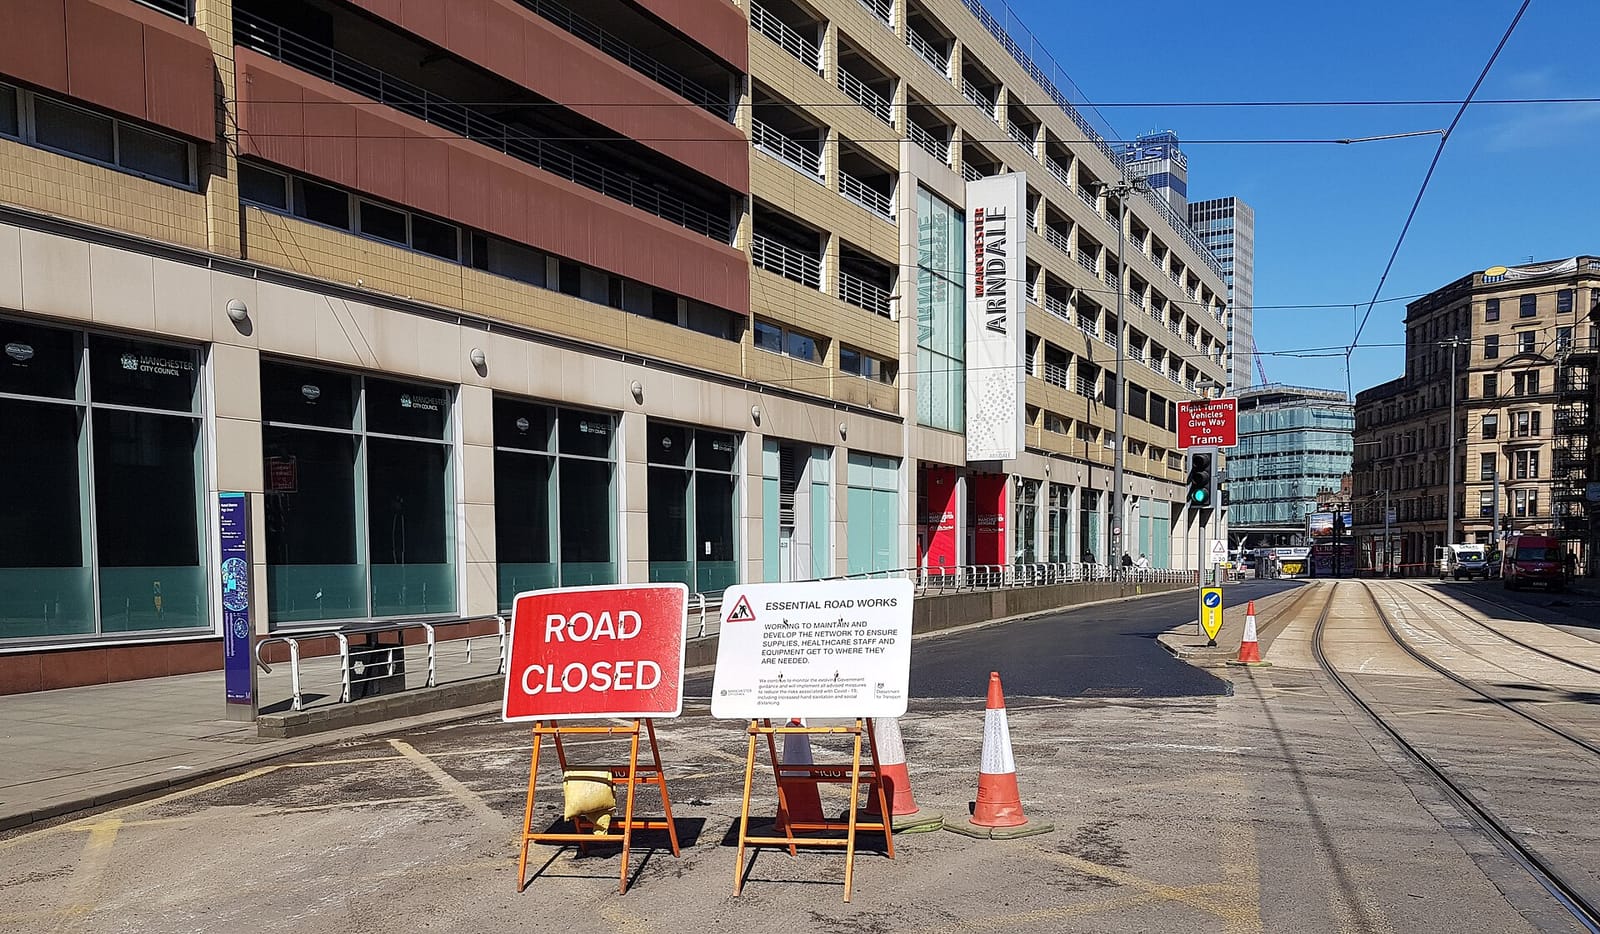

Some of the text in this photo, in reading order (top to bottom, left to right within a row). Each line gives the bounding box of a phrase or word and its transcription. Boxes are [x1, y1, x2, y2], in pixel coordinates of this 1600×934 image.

[974, 207, 984, 298] MANCHESTER
[985, 206, 1007, 335] ARNDALE
[140, 355, 194, 371] MANCHESTER
[140, 364, 180, 377] CITY COUNCIL
[1190, 411, 1223, 419] Vehicles
[1188, 418, 1226, 427] Give Way
[1190, 435, 1223, 445] Trams
[765, 598, 898, 611] ESSENTIAL ROAD WORKS
[544, 610, 643, 643] ROAD
[764, 622, 800, 630] WORKING
[813, 621, 850, 629] MAINTAIN
[851, 620, 868, 628] AND
[763, 631, 797, 639] DEVELOP
[799, 630, 813, 638] THE
[814, 630, 852, 638] NETWORK
[855, 629, 865, 637] TO
[762, 637, 896, 648] SUPPLIES, HEALTHCARE STAFF AND
[835, 647, 863, 655] WHERE
[865, 646, 886, 654] THEY
[761, 656, 811, 665] ARE NEEDED.
[521, 660, 662, 696] CLOSED
